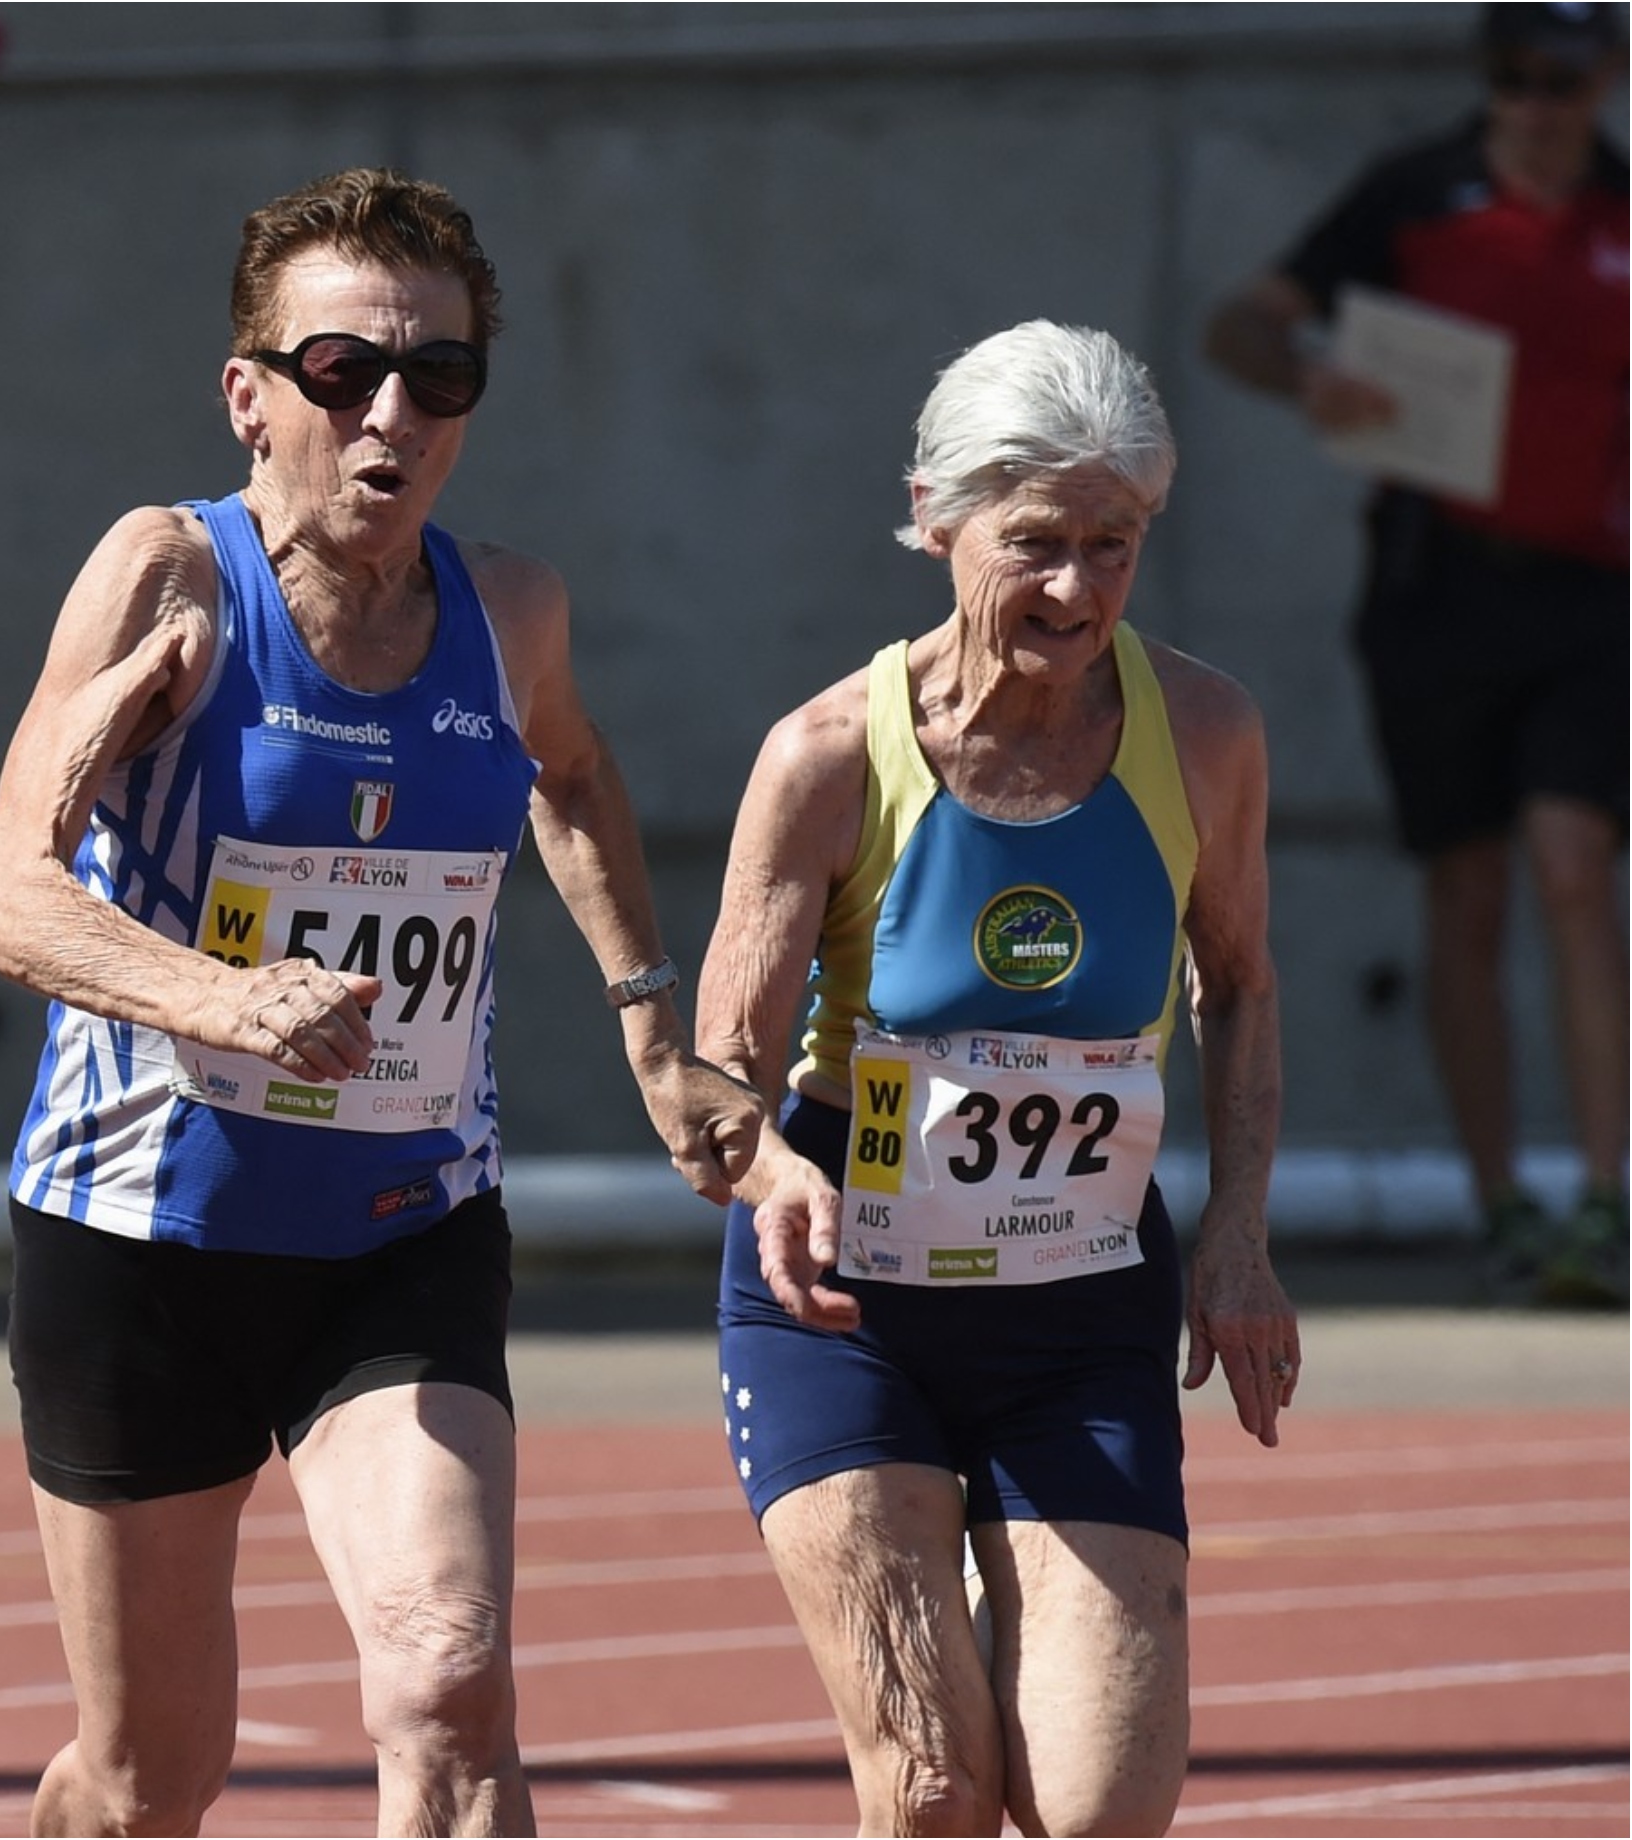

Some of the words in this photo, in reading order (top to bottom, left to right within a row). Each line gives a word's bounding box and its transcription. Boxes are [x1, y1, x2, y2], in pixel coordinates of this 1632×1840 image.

[281, 707, 391, 746] Findomestic
[357, 783, 388, 796] FIDAL
[364, 858, 392, 869] VILLE
[394, 858, 410, 870] DE
[360, 869, 409, 887] LYON
[218, 903, 256, 944] W
[1012, 942, 1070, 958] MASTERS
[998, 956, 1064, 972] ATHLETICS
[1004, 1040, 1033, 1052] VILLE
[1002, 1052, 1048, 1069] LYON
[268, 1091, 312, 1109] erima
[867, 1078, 903, 1117] W
[947, 1090, 1121, 1185] 392
[857, 1129, 902, 1167] 80
[856, 1201, 891, 1229] AUS
[985, 1209, 1075, 1238] LARMOUR
[1033, 1232, 1128, 1266] GRANDLYON
[930, 1258, 974, 1272] erima
